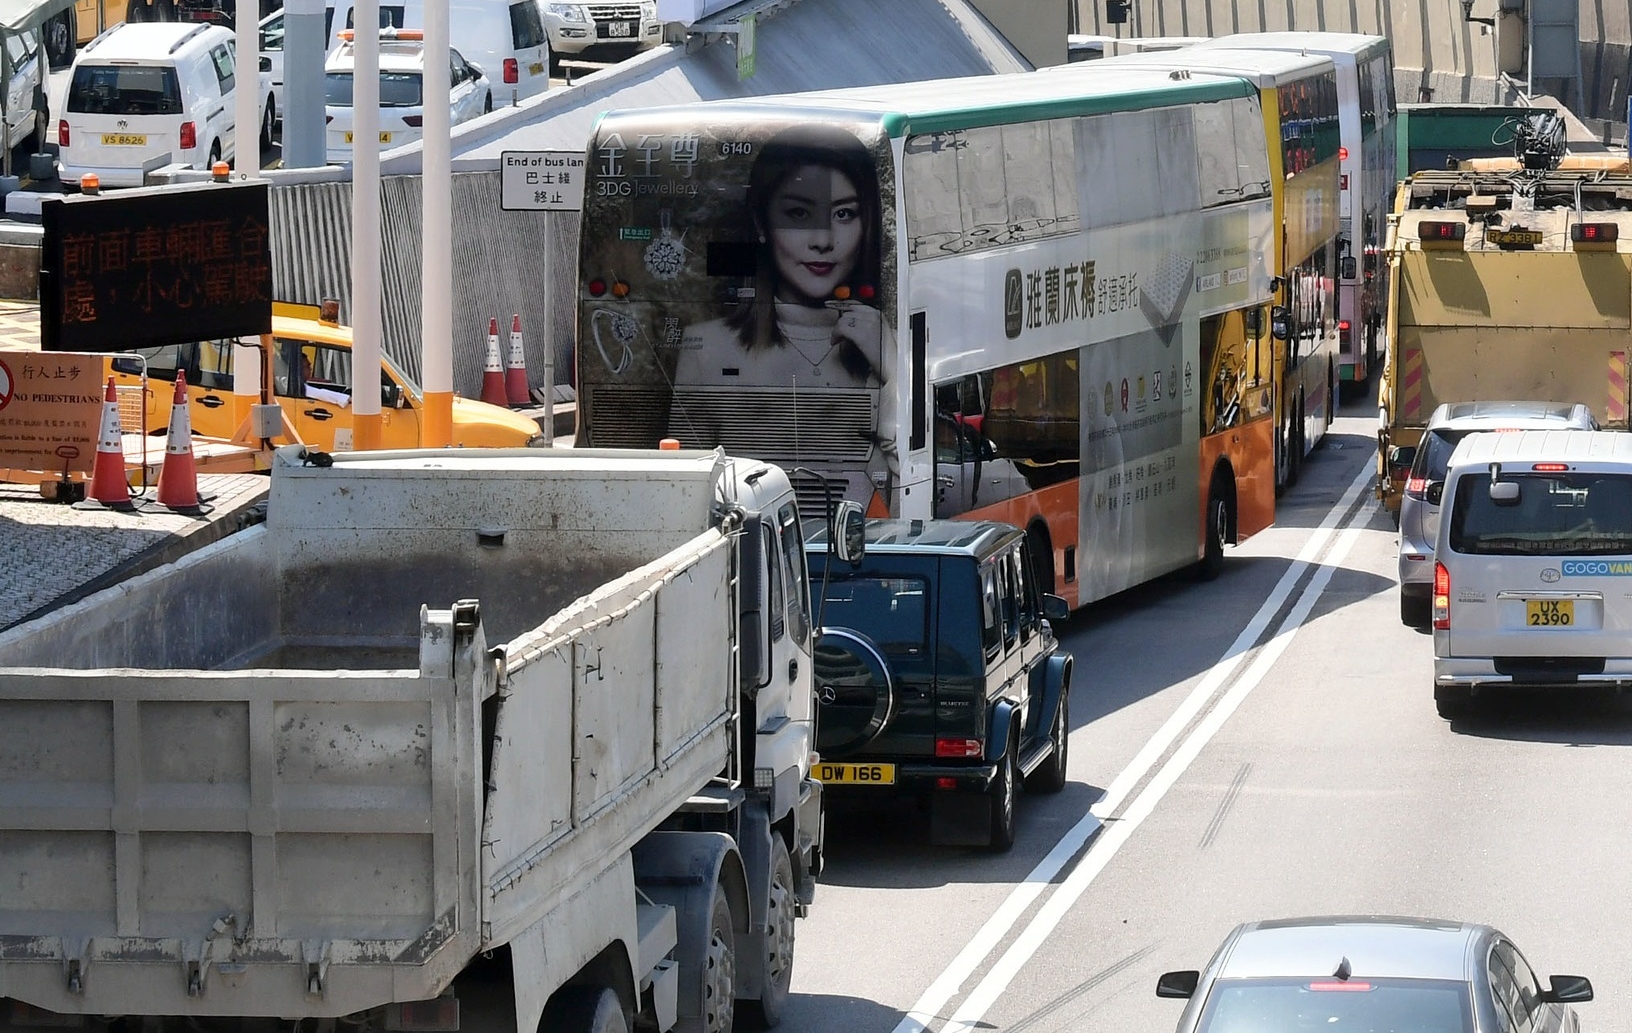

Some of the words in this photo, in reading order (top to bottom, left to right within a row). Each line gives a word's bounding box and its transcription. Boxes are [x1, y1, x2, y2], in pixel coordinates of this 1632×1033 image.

[104, 135, 116, 145] VS
[118, 136, 144, 145] 8626
[596, 132, 701, 179] 金至尊
[721, 142, 752, 155] 6140
[507, 157, 529, 167] End
[531, 157, 542, 167] of
[544, 157, 565, 167] bus
[566, 157, 585, 167] lan
[596, 181, 632, 197] 3DG
[534, 190, 563, 204] 終止
[1509, 232, 1540, 243] 3381
[1025, 259, 1097, 330] 雅蘭床褥
[1097, 271, 1138, 315] 舒適承托
[22, 364, 82, 381] 行人止步
[14, 393, 28, 402] NO
[32, 393, 101, 404] PEDESTRIANS
[1540, 600, 1559, 614] UX
[1531, 613, 1570, 626] 2390
[822, 766, 846, 781] DW
[852, 766, 882, 781] 166
